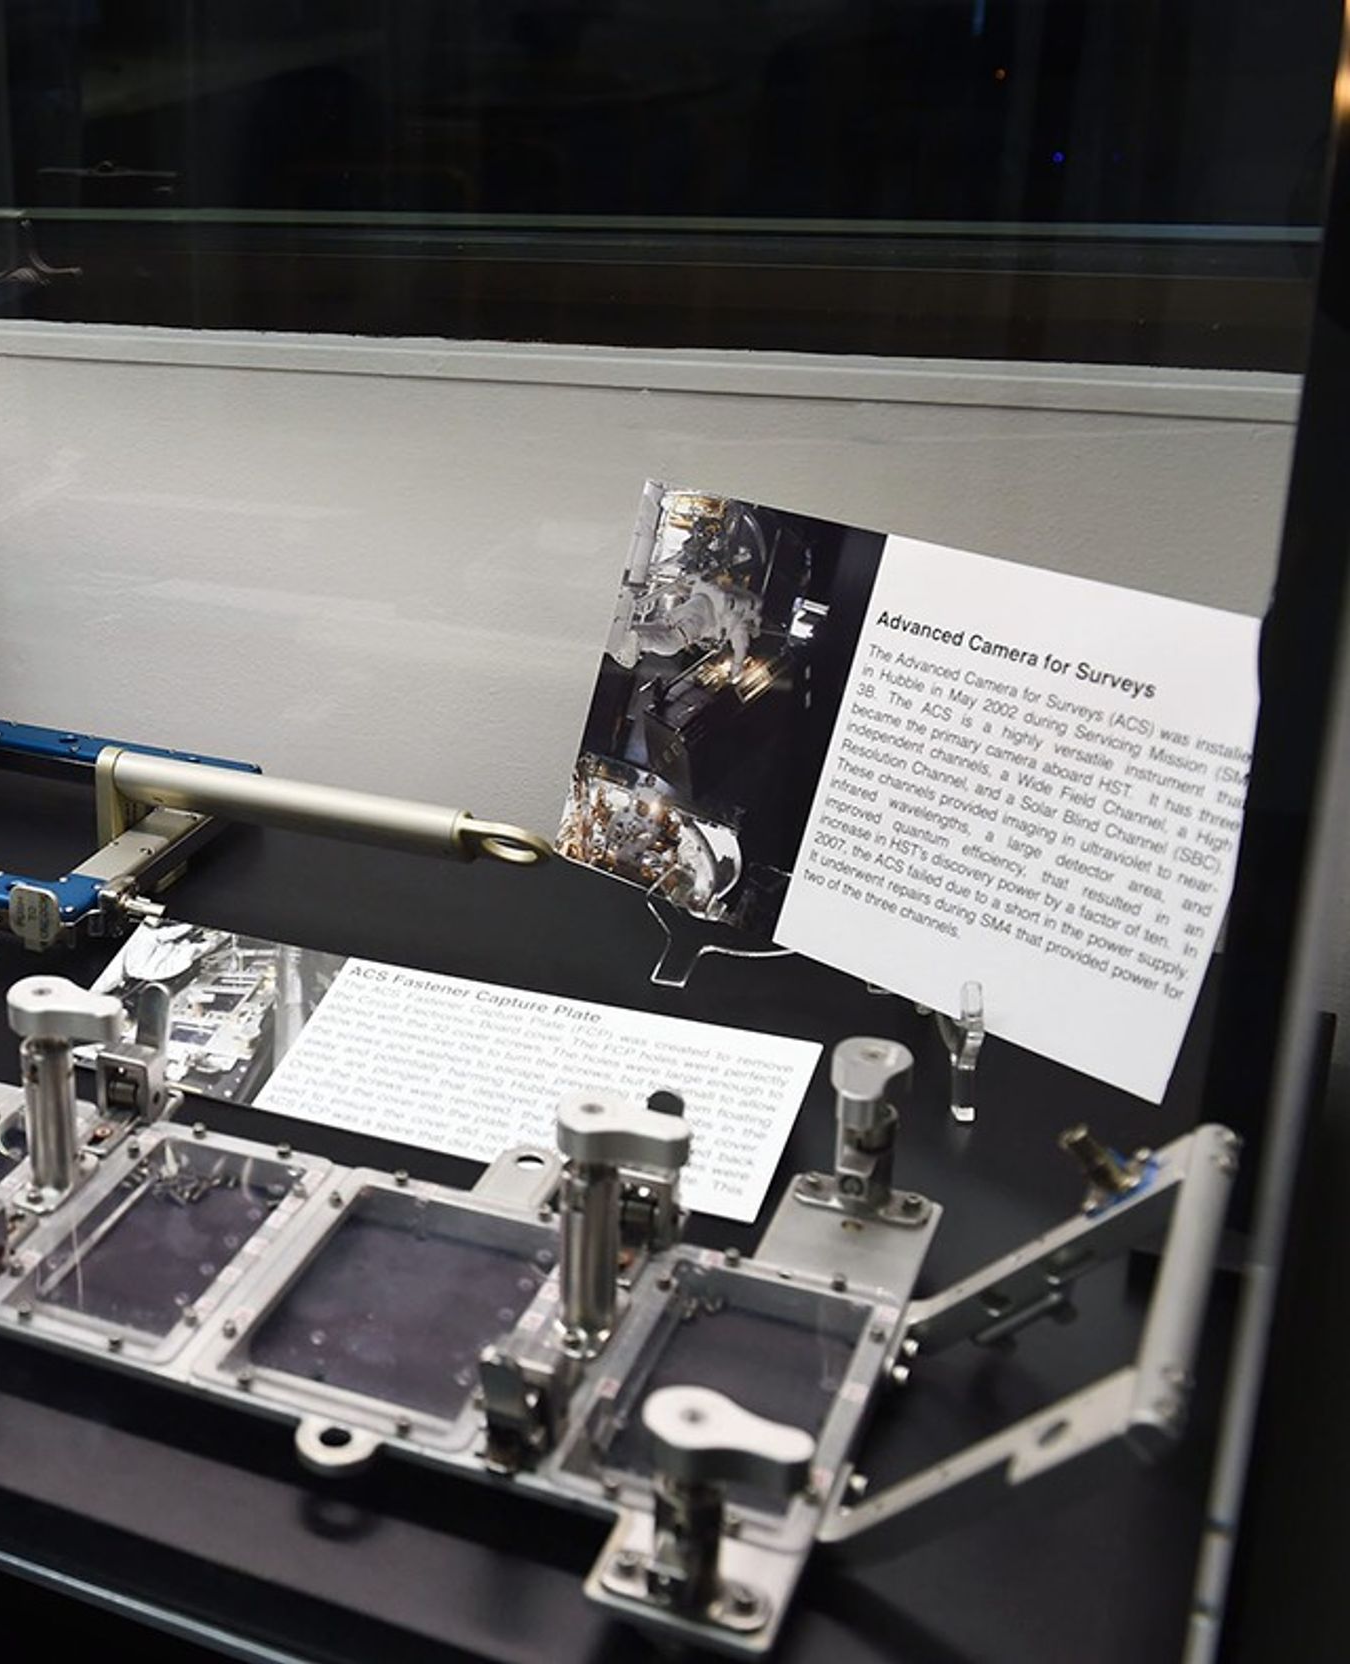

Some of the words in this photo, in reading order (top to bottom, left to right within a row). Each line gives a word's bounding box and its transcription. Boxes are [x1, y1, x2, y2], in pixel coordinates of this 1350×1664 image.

[869, 643, 892, 661] The
[894, 652, 961, 681] Advanced
[963, 670, 1017, 697] Camera
[1022, 686, 1041, 702] for
[1045, 693, 1103, 722] Surveys
[1108, 711, 1154, 738] (ACS)
[1159, 729, 1189, 746] was
[876, 610, 964, 646] Advanced
[968, 634, 1038, 666] Camera
[1043, 654, 1070, 674] for
[1075, 662, 1155, 698] Surveys
[850, 701, 901, 727] became
[905, 719, 927, 735] the
[929, 728, 981, 754] primary
[984, 744, 1037, 769] camera
[1041, 762, 1094, 786] aboard
[1148, 792, 1159, 807] It
[1164, 798, 1192, 817] has
[1198, 808, 1238, 830] three
[861, 663, 873, 677] in
[878, 667, 924, 692] Hubble
[930, 682, 943, 697] in
[947, 687, 978, 710] May
[982, 698, 1018, 719] 2002
[1023, 711, 1068, 737] during
[1073, 723, 1142, 759] Servicing
[1148, 745, 1207, 774] Mission
[889, 690, 912, 709] The
[920, 701, 952, 721] ACS
[960, 713, 972, 728] is
[982, 721, 992, 733] a
[1001, 725, 1043, 751] highly
[1054, 743, 1113, 770] versatile
[1124, 764, 1205, 797] instrument
[1216, 790, 1246, 807] tha
[837, 755, 874, 780] These
[877, 773, 936, 801] channels
[938, 793, 998, 821] provided
[1001, 811, 1057, 844] imaging
[1061, 832, 1075, 847] in
[1080, 840, 1152, 873] ultraviolet
[1156, 864, 1171, 879] to
[840, 737, 907, 769] Resolution
[911, 760, 968, 791] Channel,
[974, 783, 1002, 800] and
[1004, 793, 1015, 805] a
[1019, 795, 1057, 818] Solar
[1062, 808, 1101, 832] Blind
[1104, 822, 1168, 853] Channel
[846, 719, 924, 754] independent
[999, 769, 1009, 781] a
[1017, 772, 1052, 795] Wide
[1059, 785, 1096, 808] Field
[1102, 799, 1167, 833] Channel,
[1176, 826, 1187, 838] a
[1195, 830, 1230, 852] High
[803, 868, 825, 885] two
[826, 878, 841, 890] of
[841, 883, 862, 900] the
[864, 891, 897, 913] three
[818, 811, 871, 840] increase
[873, 830, 886, 846] in
[888, 836, 928, 861] HST's
[930, 853, 995, 887] discovery
[996, 877, 1041, 901] power
[1043, 892, 1062, 911] by
[1064, 902, 1075, 914] a
[1079, 904, 1121, 929] factor
[1124, 924, 1141, 936] of
[1183, 942, 1197, 957] In
[824, 793, 882, 824] improved
[892, 820, 949, 847] quantum
[1041, 870, 1069, 890] that
[1081, 886, 1143, 916] resulted
[1154, 912, 1169, 925] in
[1183, 923, 1204, 937] an
[829, 774, 878, 802] infrared
[888, 798, 971, 837] wavelengths,
[984, 830, 994, 842] a
[1006, 835, 1042, 859] large
[1054, 854, 1114, 882] detector
[1181, 898, 1212, 917] and
[851, 845, 871, 861] the
[873, 852, 905, 873] ACS
[906, 863, 943, 887] failed
[944, 879, 971, 898] due
[974, 889, 988, 904] to
[990, 897, 1000, 909] a
[1004, 902, 1040, 923] short
[1042, 914, 1056, 929] in
[1060, 921, 1084, 939] the
[1086, 933, 1133, 957] power
[808, 848, 818, 862] It
[820, 855, 884, 887] underwent
[886, 880, 931, 905] repairs
[934, 897, 976, 924] during
[979, 912, 1012, 934] SM4
[1015, 927, 1043, 947] that
[1044, 940, 1109, 972] provided
[1110, 965, 1158, 989] power
[1163, 982, 1184, 999] for
[348, 966, 388, 981] ACS
[392, 974, 469, 997] Fastener
[475, 990, 548, 1012] Capture
[553, 1004, 601, 1022] Plate
